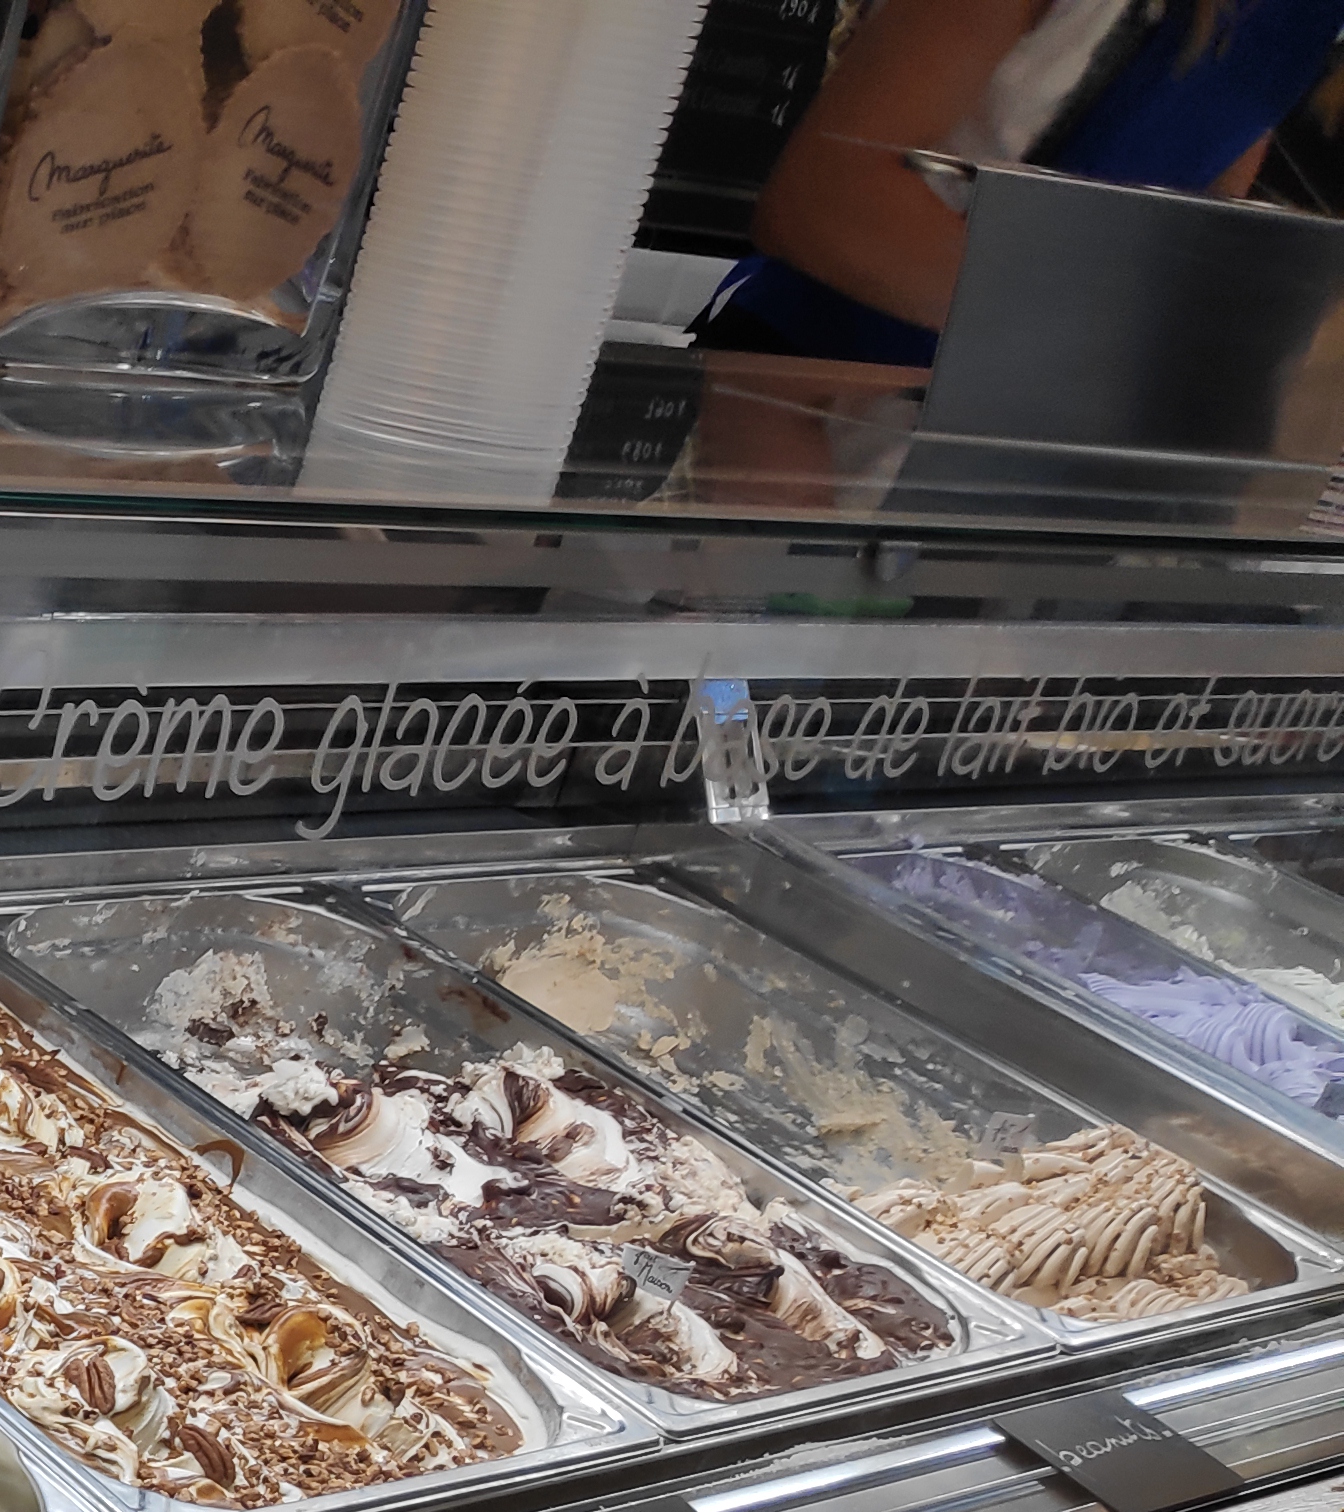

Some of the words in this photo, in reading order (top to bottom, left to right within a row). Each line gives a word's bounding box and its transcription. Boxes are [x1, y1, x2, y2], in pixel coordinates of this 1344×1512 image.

[294, 664, 578, 841] glacée
[595, 672, 650, 791] à
[844, 664, 930, 781] de
[937, 664, 1049, 779] lait
[1042, 672, 1140, 775] bio
